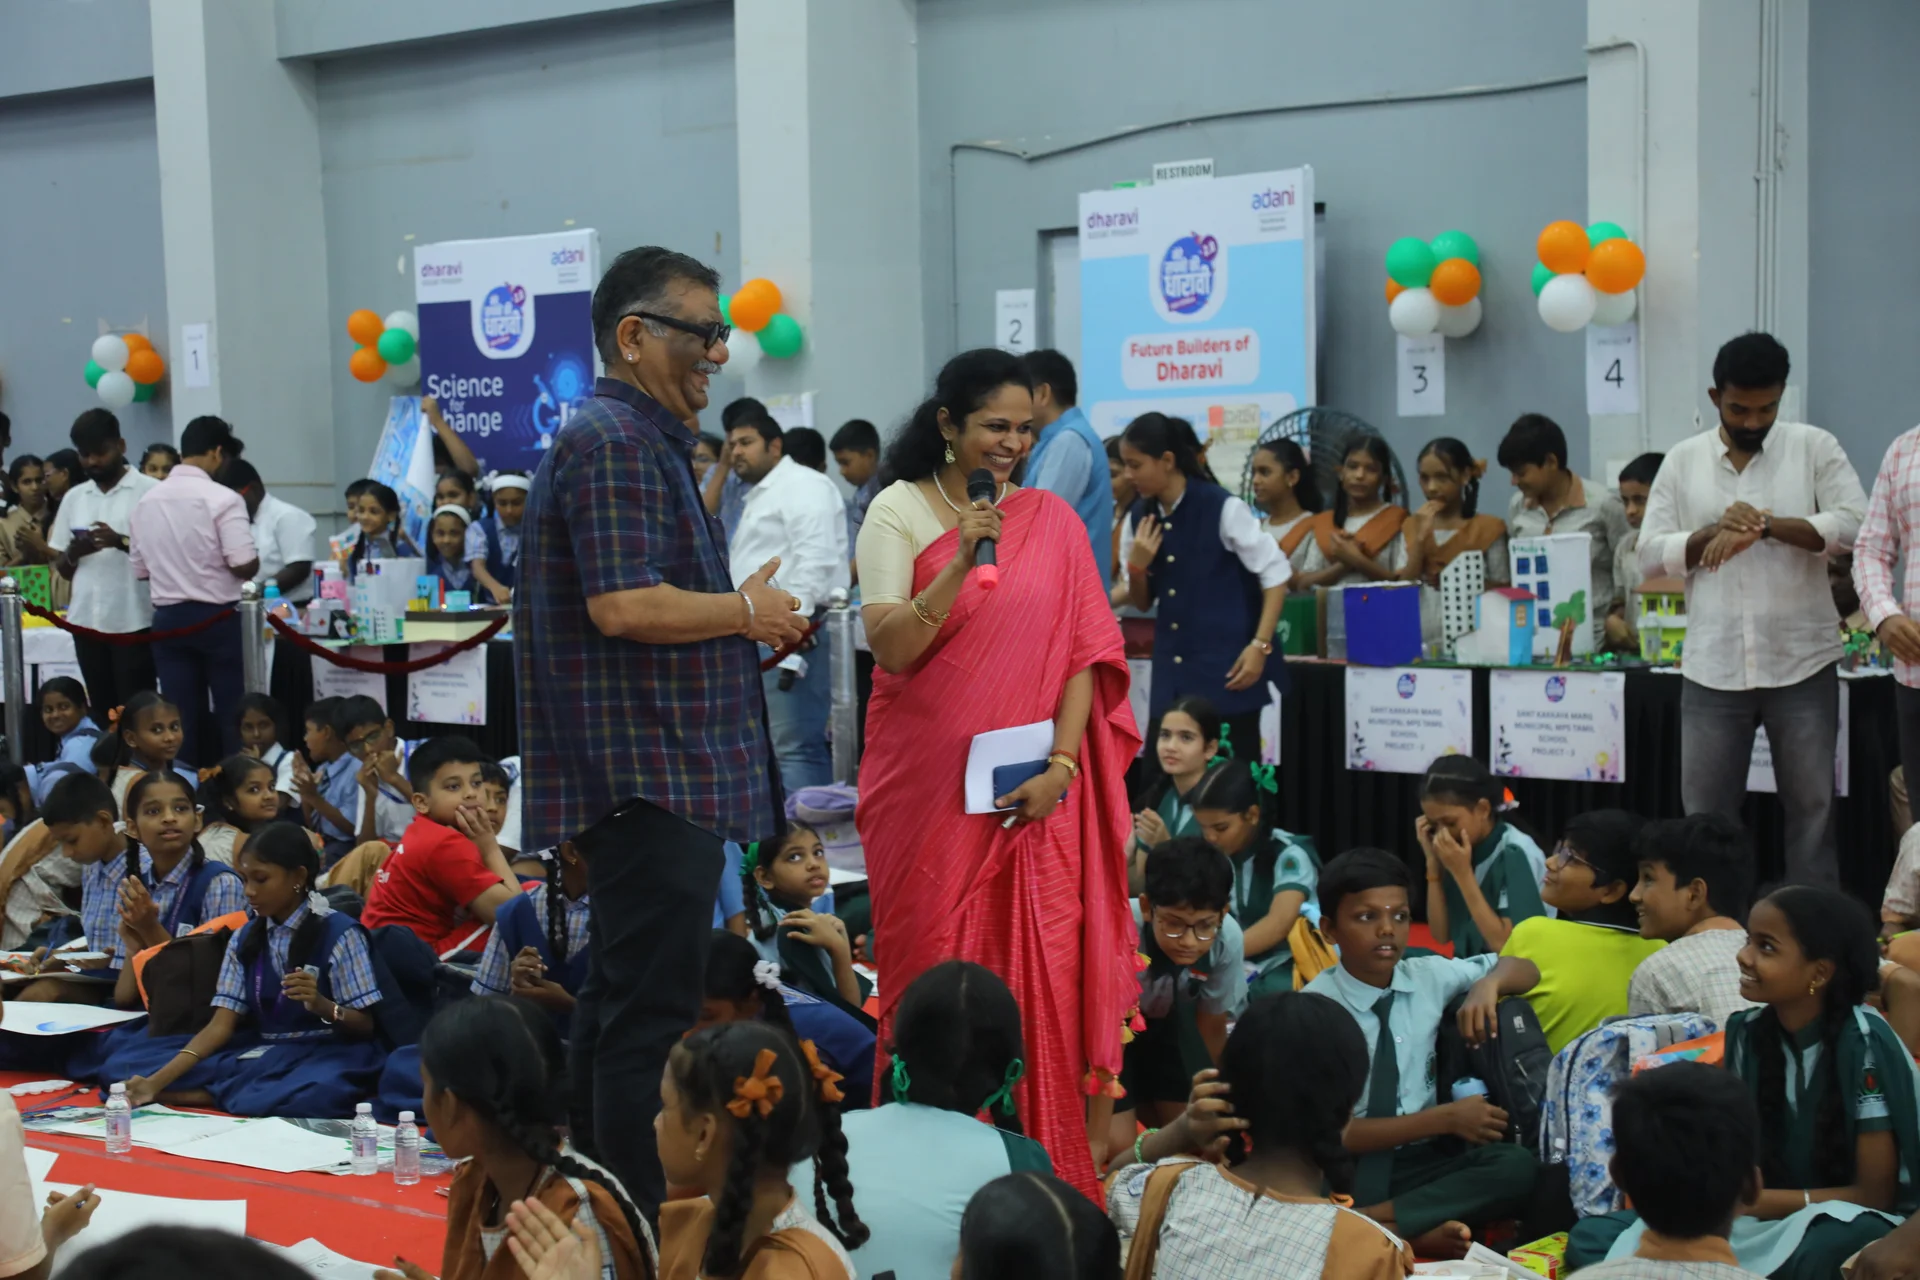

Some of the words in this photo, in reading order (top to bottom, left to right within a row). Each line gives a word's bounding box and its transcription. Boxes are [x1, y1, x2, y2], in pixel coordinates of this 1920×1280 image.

[1156, 163, 1212, 180] RESTROOM
[1251, 184, 1295, 210] adani
[1087, 207, 1139, 229] dharavi
[551, 244, 585, 266] adani
[421, 259, 463, 277] dharavi
[1009, 319, 1022, 344] 2
[1130, 342, 1173, 357] Future
[1177, 336, 1231, 355] Builders
[1235, 335, 1250, 351] of
[191, 348, 199, 371] 1
[1157, 357, 1223, 381] Dharavi
[1412, 365, 1428, 394] 3
[1604, 358, 1625, 389] 4
[427, 373, 504, 400] Science
[449, 398, 466, 413] for
[431, 408, 503, 437] hange
[1532, 747, 1565, 756] PROJECT
